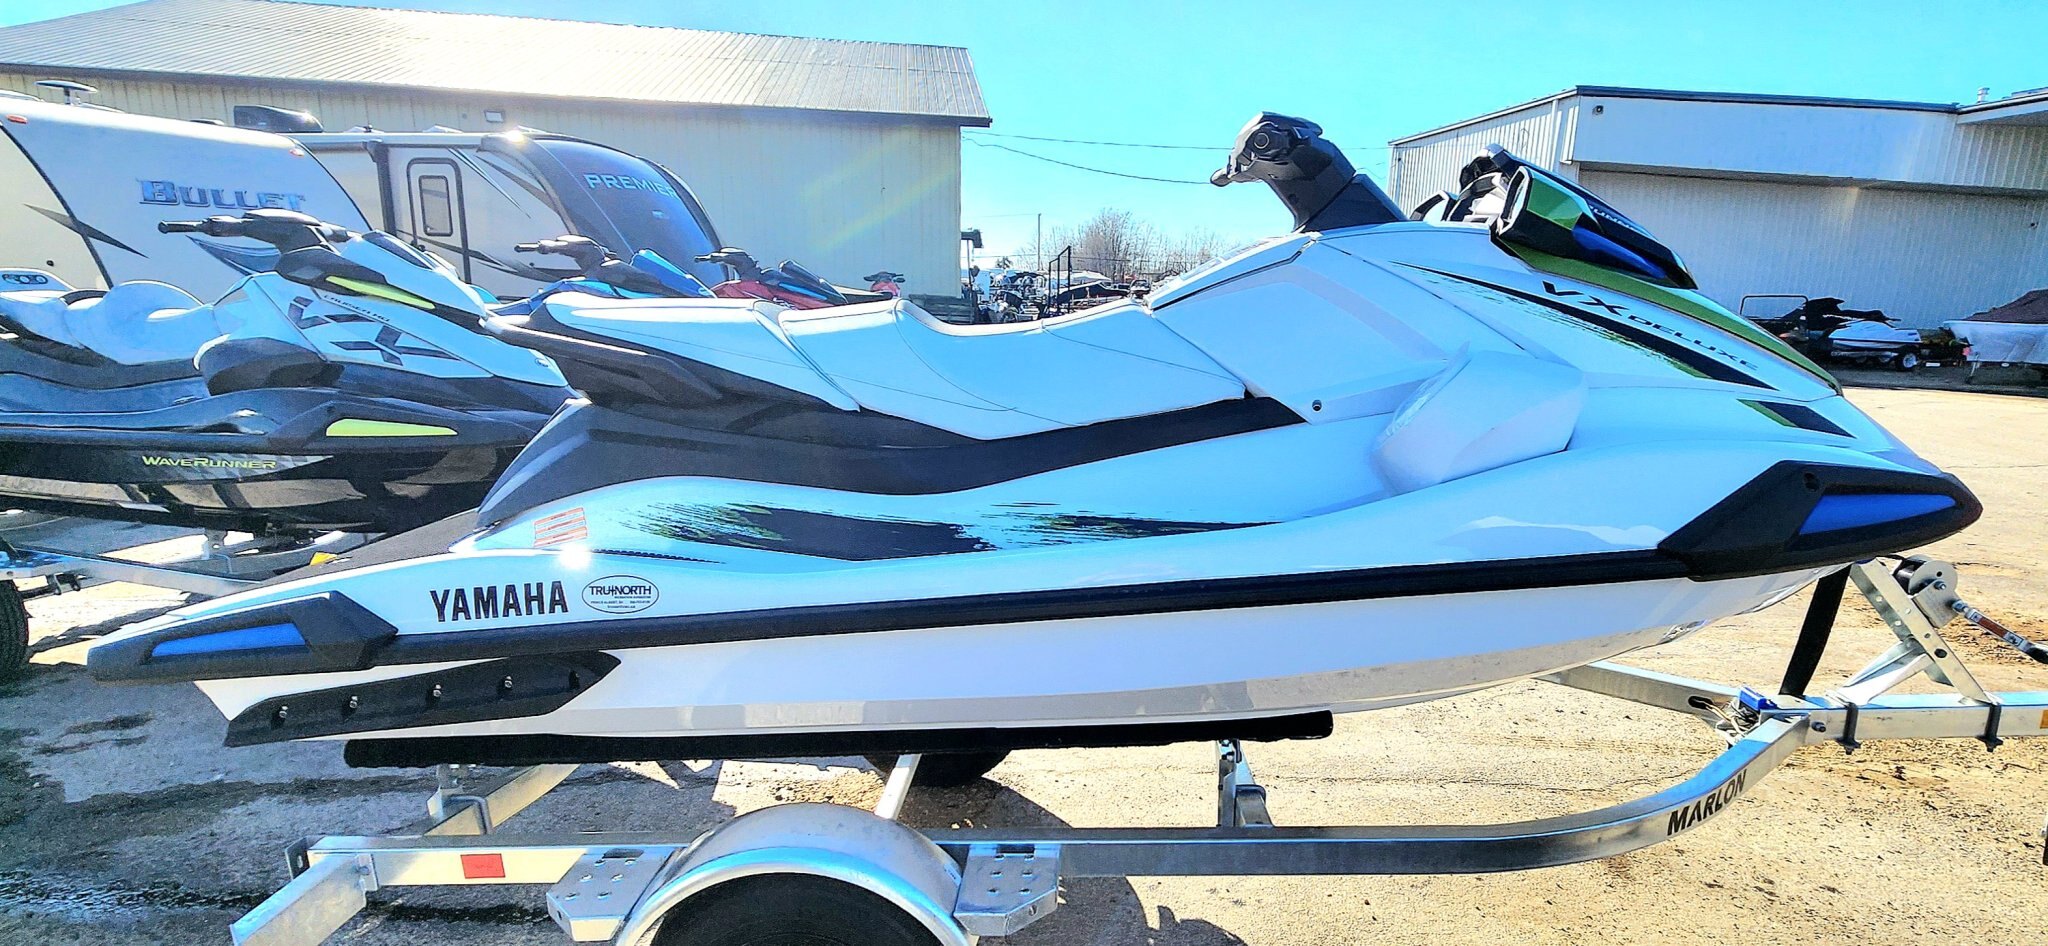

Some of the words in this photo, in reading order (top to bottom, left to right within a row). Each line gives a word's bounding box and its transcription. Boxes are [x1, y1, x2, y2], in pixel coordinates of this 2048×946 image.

[583, 172, 680, 199] PREMIER
[1542, 280, 1630, 316] VX
[1628, 314, 1759, 371] DELUXE
[142, 455, 277, 469] WAVERUNNER
[430, 580, 569, 622] YAMAHA
[1667, 768, 1747, 836] MARLON
